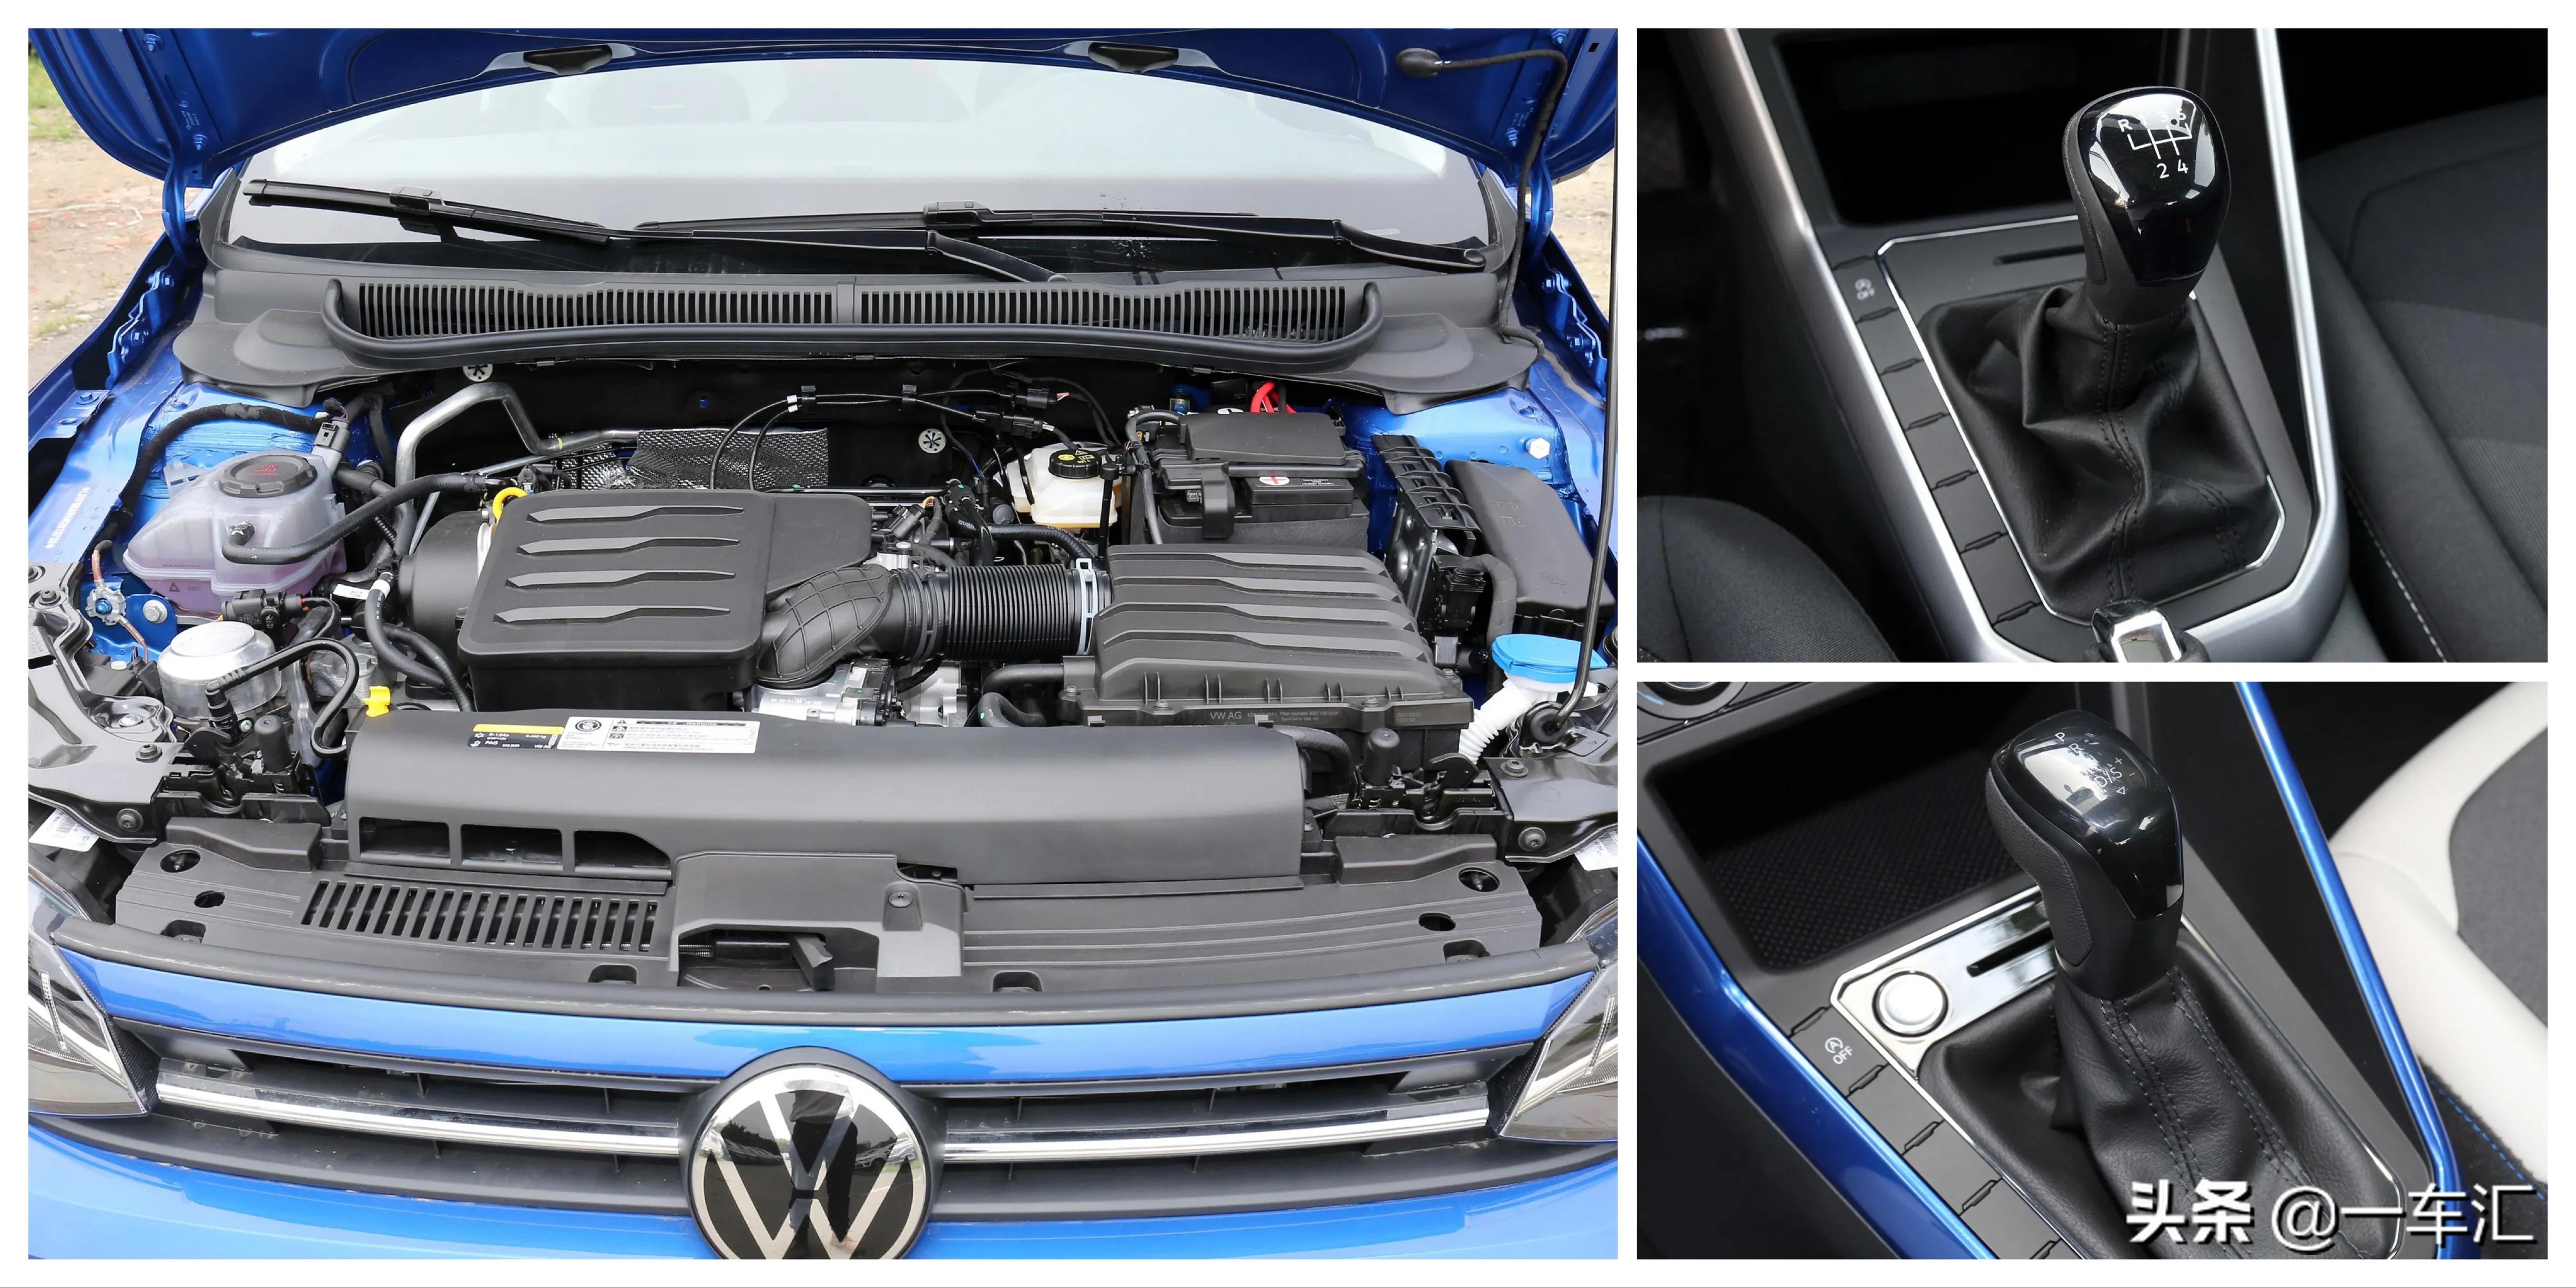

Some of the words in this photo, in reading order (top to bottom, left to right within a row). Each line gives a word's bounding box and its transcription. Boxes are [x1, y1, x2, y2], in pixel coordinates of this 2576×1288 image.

[2118, 119, 2133, 132] R
[2156, 163, 2170, 179] 2
[2177, 159, 2188, 173] 4
[1228, 711, 1241, 720] AG
[2055, 732, 2065, 742] P
[2069, 743, 2084, 754] R
[1832, 1045, 1852, 1065] OFF
